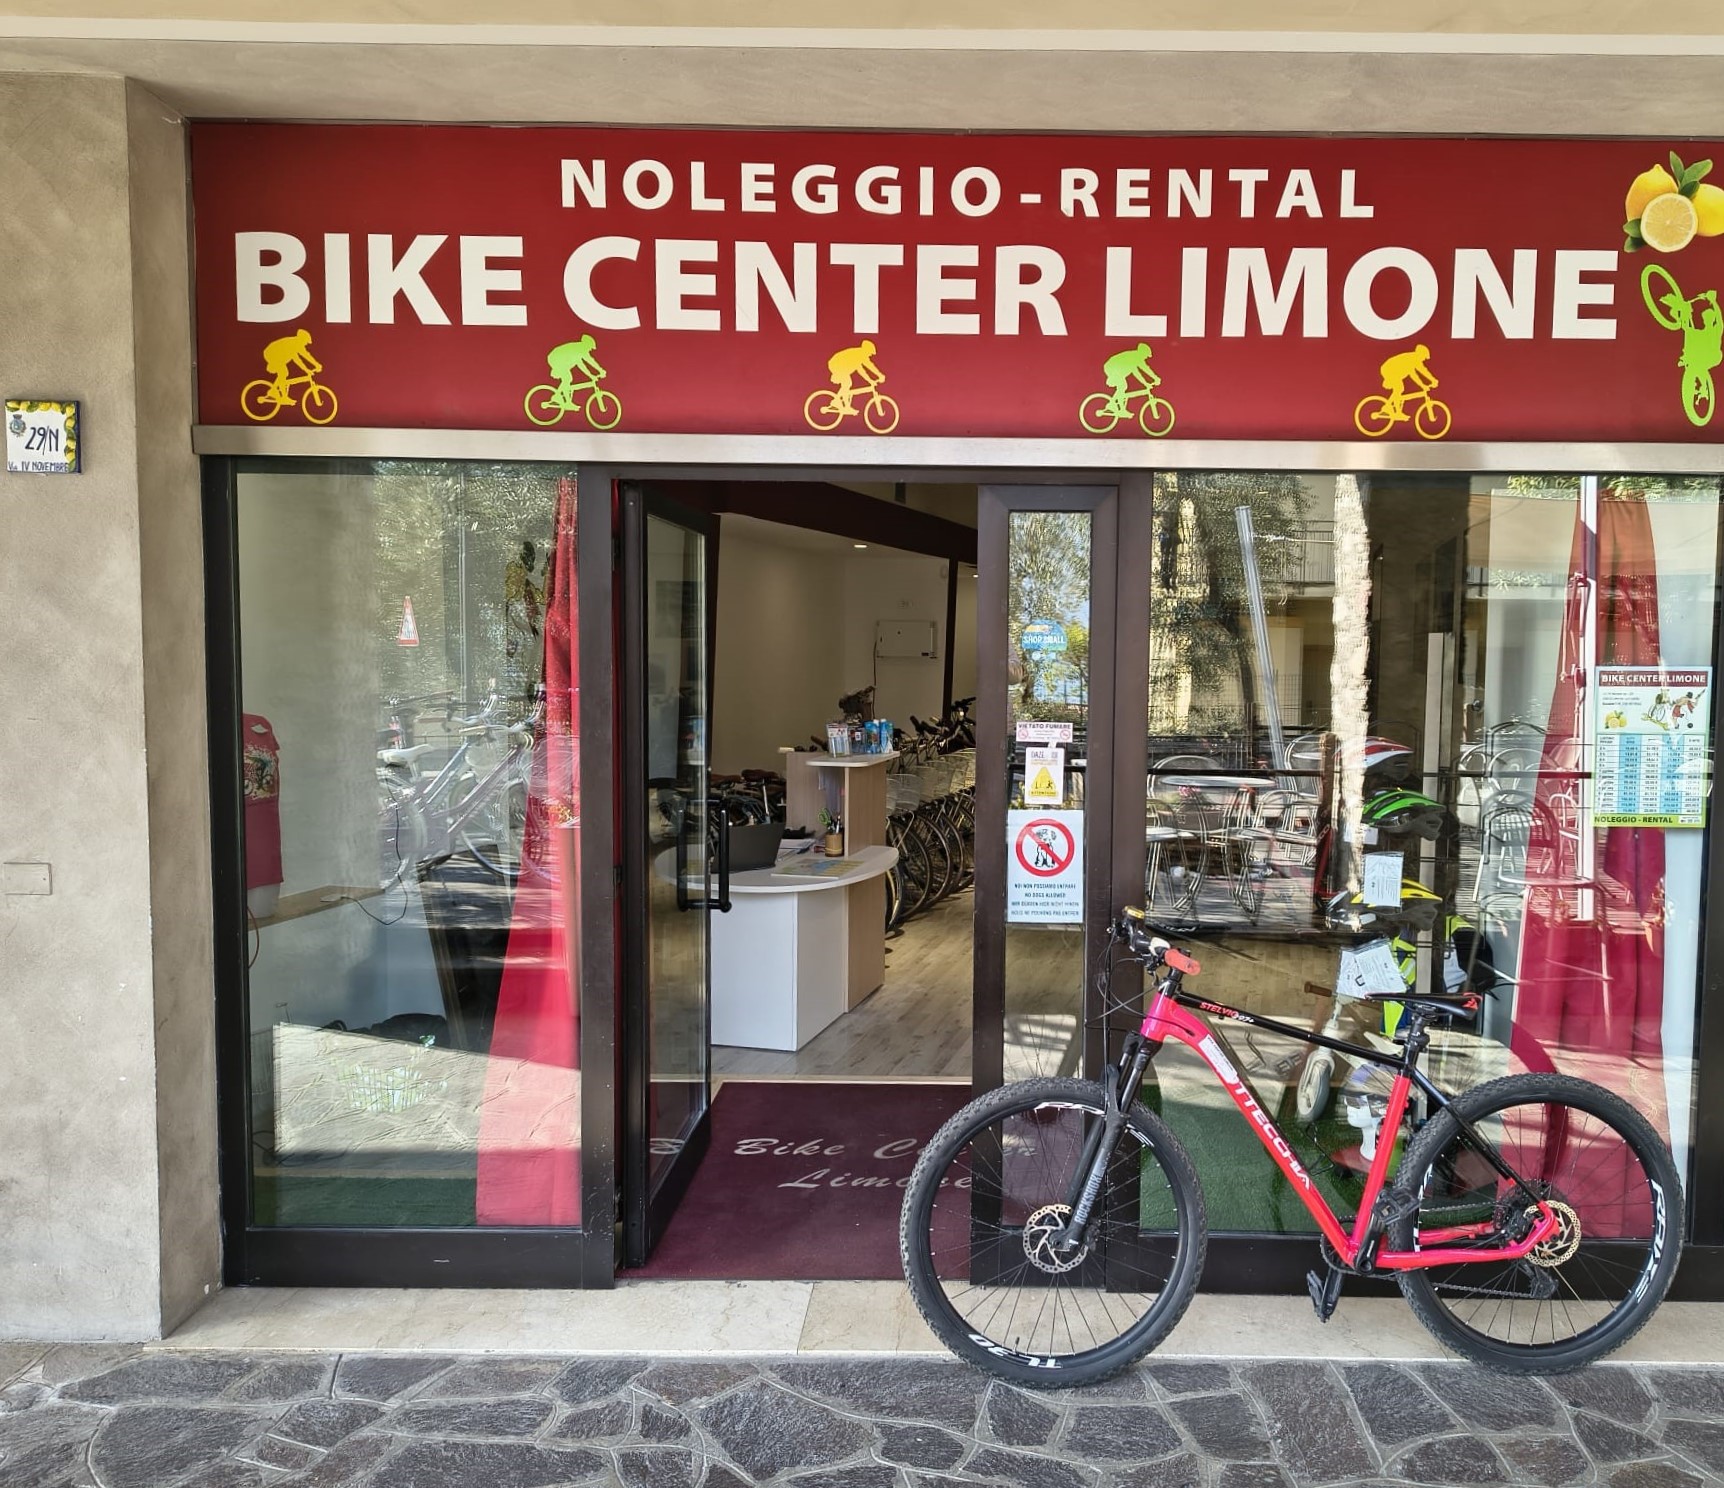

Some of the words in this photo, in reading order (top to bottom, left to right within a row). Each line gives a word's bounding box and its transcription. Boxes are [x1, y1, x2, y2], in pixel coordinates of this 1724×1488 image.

[234, 231, 528, 327] BIKE
[563, 236, 1068, 336] CENTER
[1104, 246, 1619, 341] LIMONE
[25, 426, 59, 456] 29/N
[21, 461, 30, 470] IV
[1022, 635, 1042, 645] SHOP
[1602, 674, 1625, 682] BIKE
[1626, 674, 1665, 683] CENTER
[1666, 674, 1706, 683] LIMONE
[1200, 1001, 1237, 1019] STELVIO
[1233, 1080, 1310, 1190] TTECCHIA
[734, 1138, 845, 1155] Bike
[777, 1168, 972, 1189] Lime
[1074, 1173, 1103, 1226] ROCKSHOX
